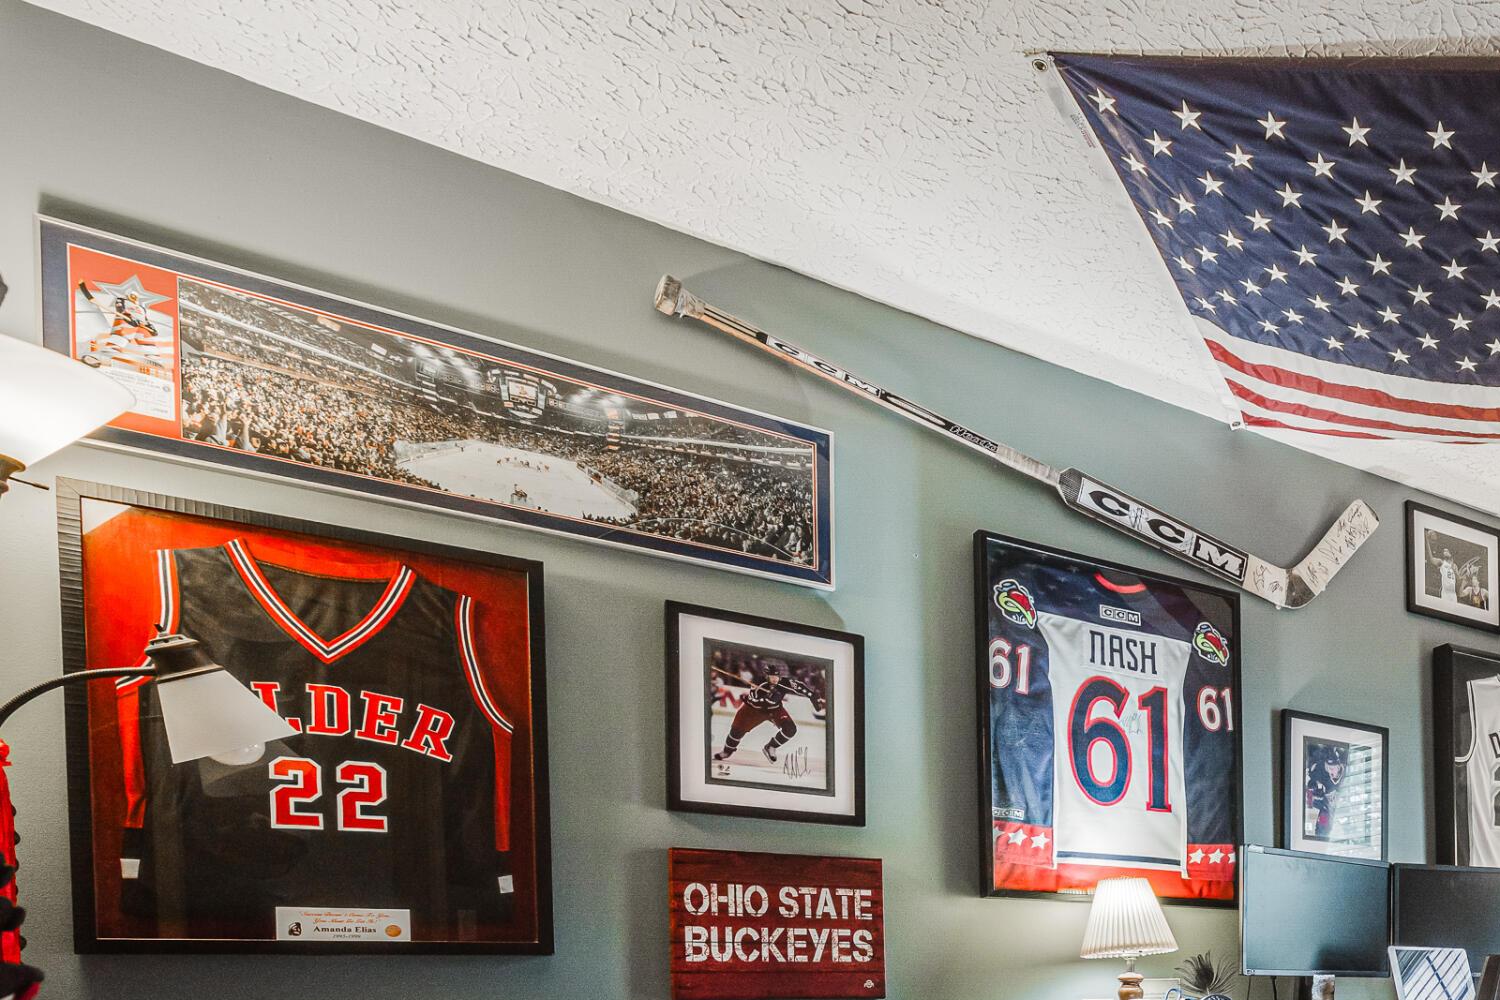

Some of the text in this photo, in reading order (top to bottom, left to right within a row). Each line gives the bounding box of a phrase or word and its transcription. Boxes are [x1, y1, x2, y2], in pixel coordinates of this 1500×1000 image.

[773, 341, 881, 398] CCM
[1088, 489, 1245, 580] CCM
[1101, 605, 1140, 625] CCM
[988, 638, 1030, 695] 61
[1088, 629, 1158, 675] NASH
[250, 681, 456, 763] LDER
[1197, 686, 1234, 732] 61
[1067, 675, 1172, 813] 61
[268, 756, 388, 833] 22
[683, 882, 873, 920] OHIO STATE
[354, 926, 377, 934] Elias
[684, 925, 874, 963] BUCKEYES
